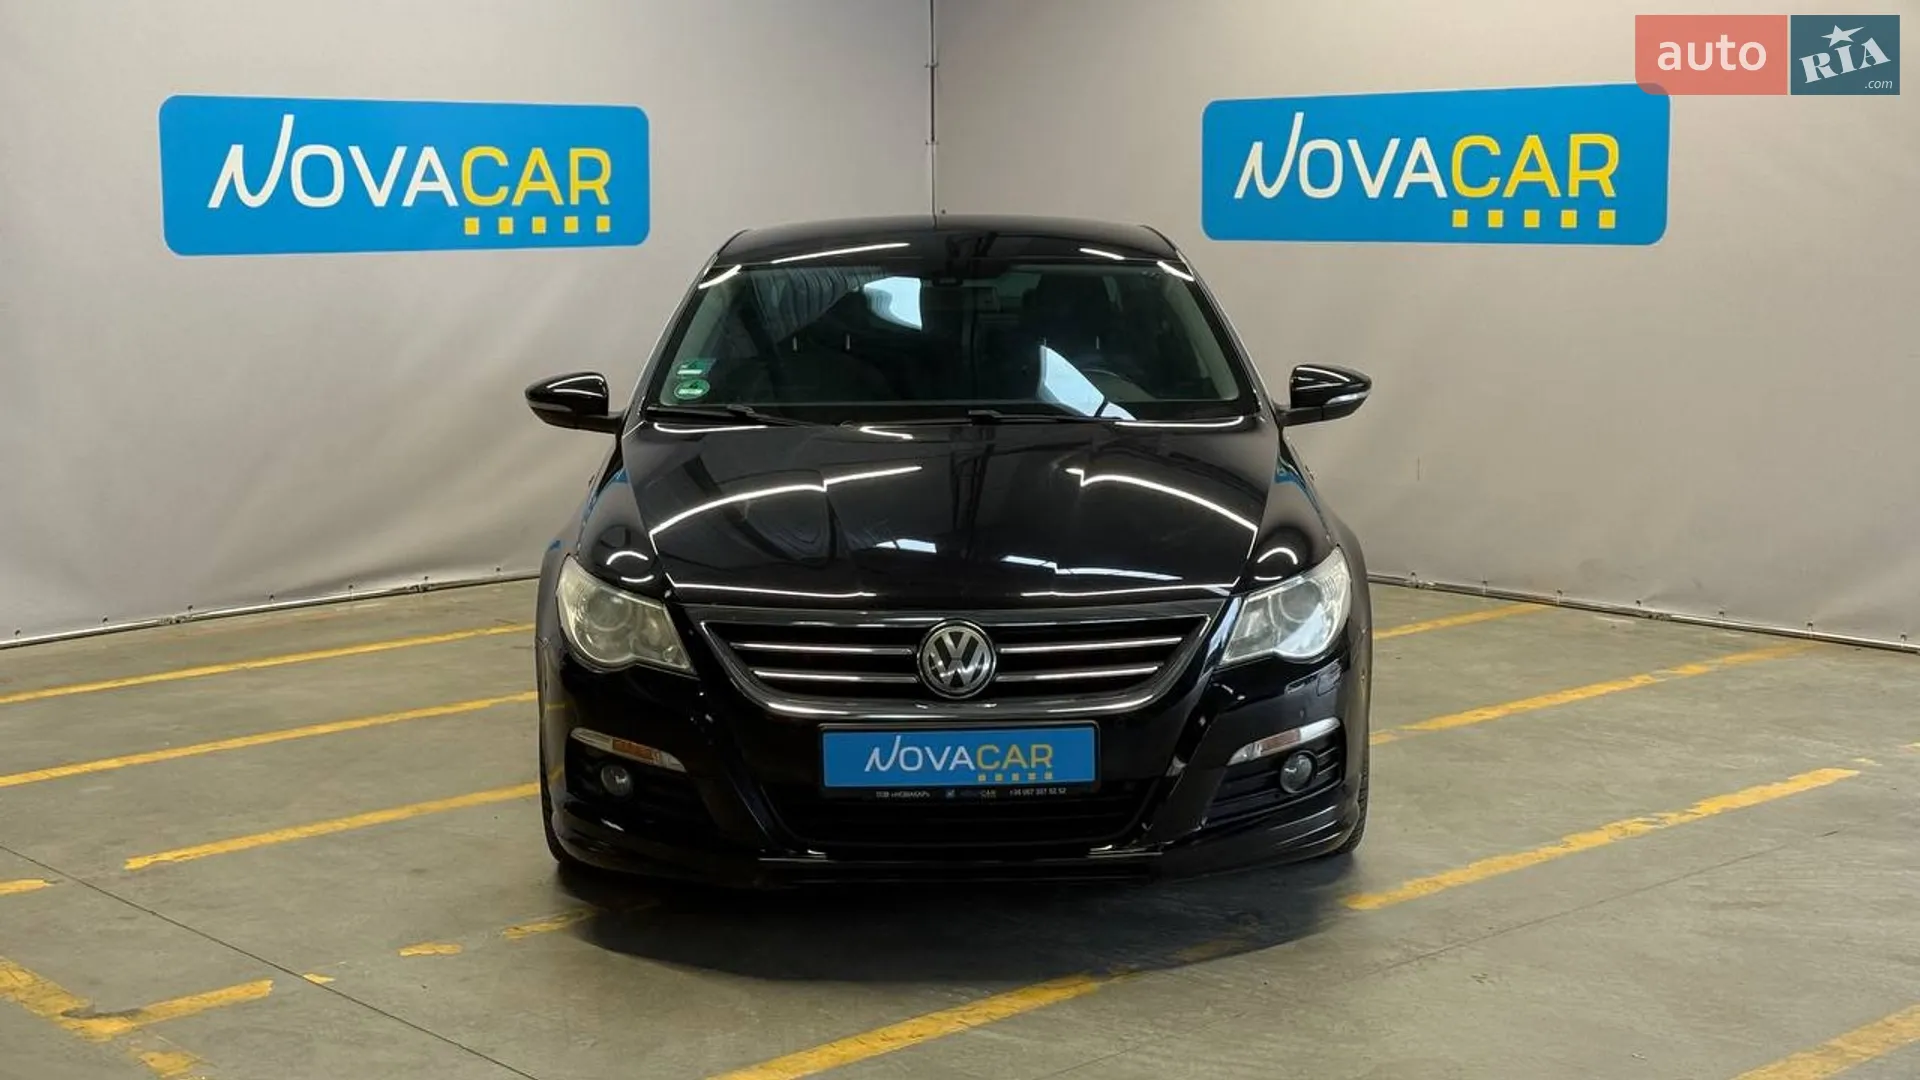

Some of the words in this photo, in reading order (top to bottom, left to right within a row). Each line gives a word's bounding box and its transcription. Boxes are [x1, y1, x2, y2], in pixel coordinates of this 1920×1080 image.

[208, 114, 612, 208] NOVACAR
[1234, 112, 1620, 199] NOVACAR
[864, 735, 1054, 772] NOVACAR
